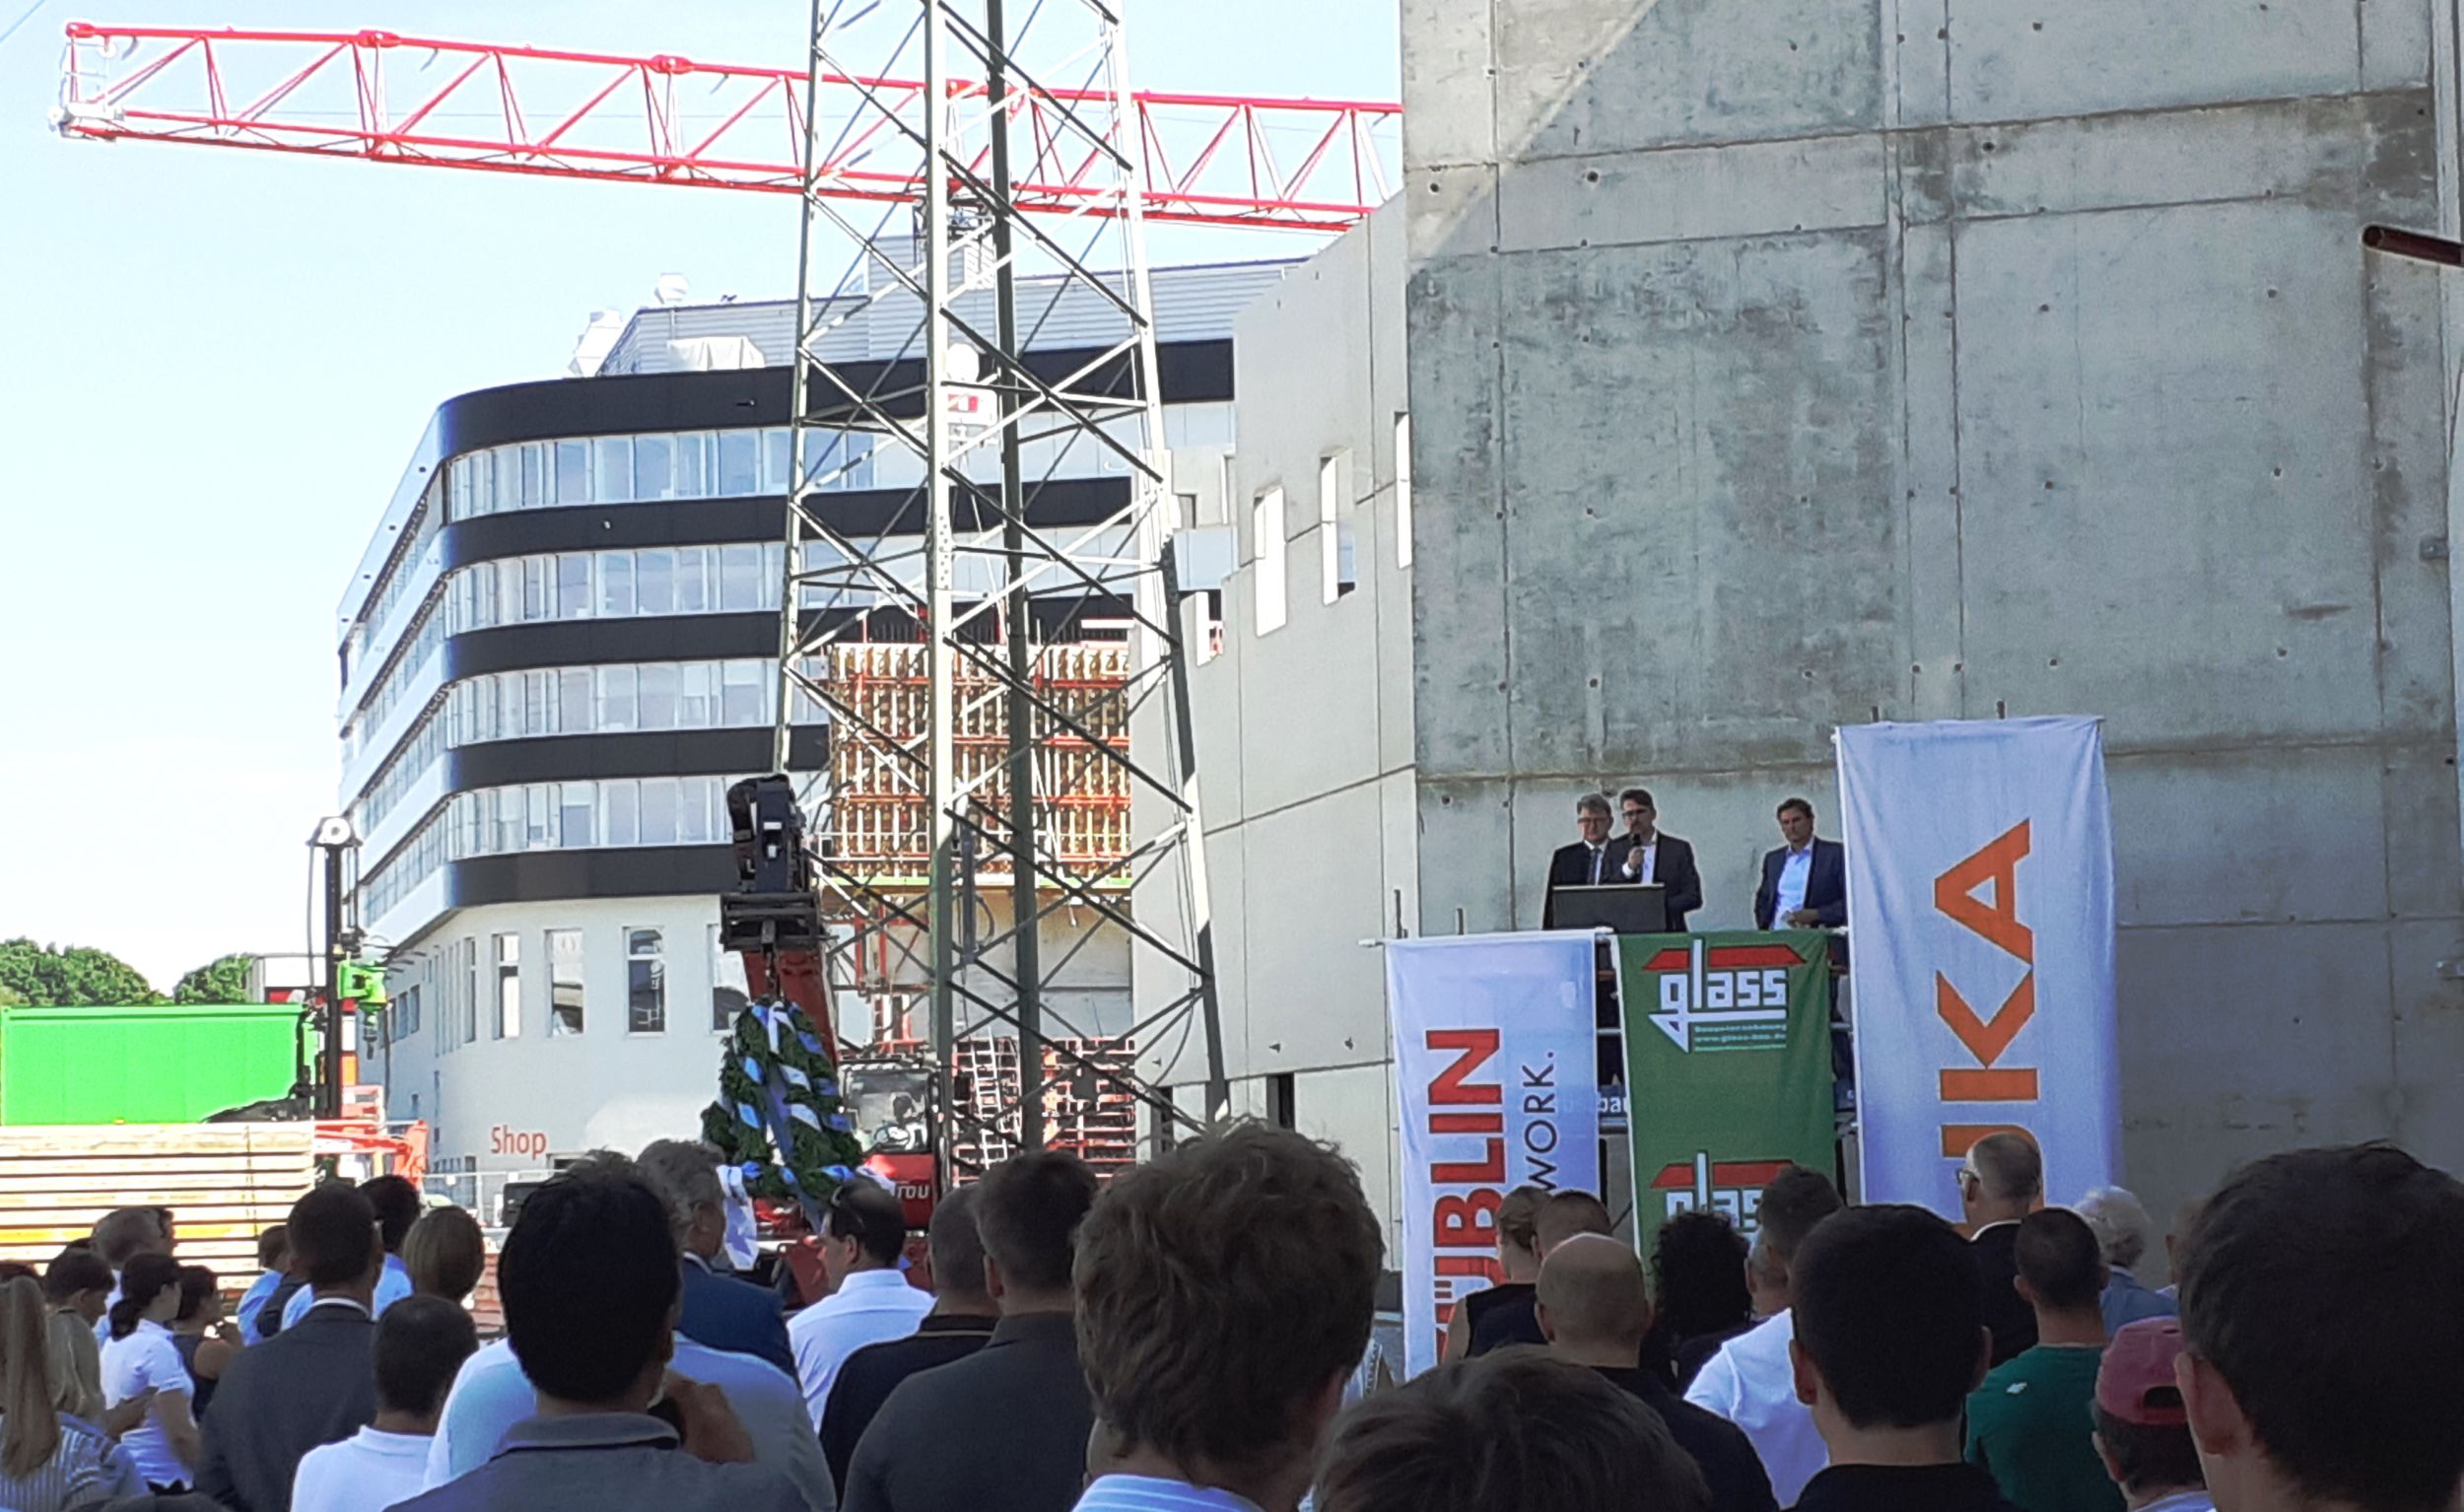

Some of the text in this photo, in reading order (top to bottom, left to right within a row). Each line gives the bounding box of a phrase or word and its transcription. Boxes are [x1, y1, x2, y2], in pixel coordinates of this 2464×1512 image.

[1648, 939, 1787, 1053] glass
[491, 1125, 547, 1161] Shop
[1522, 1051, 1558, 1191] WORK.
[1425, 1028, 1508, 1365] ÜBLIN
